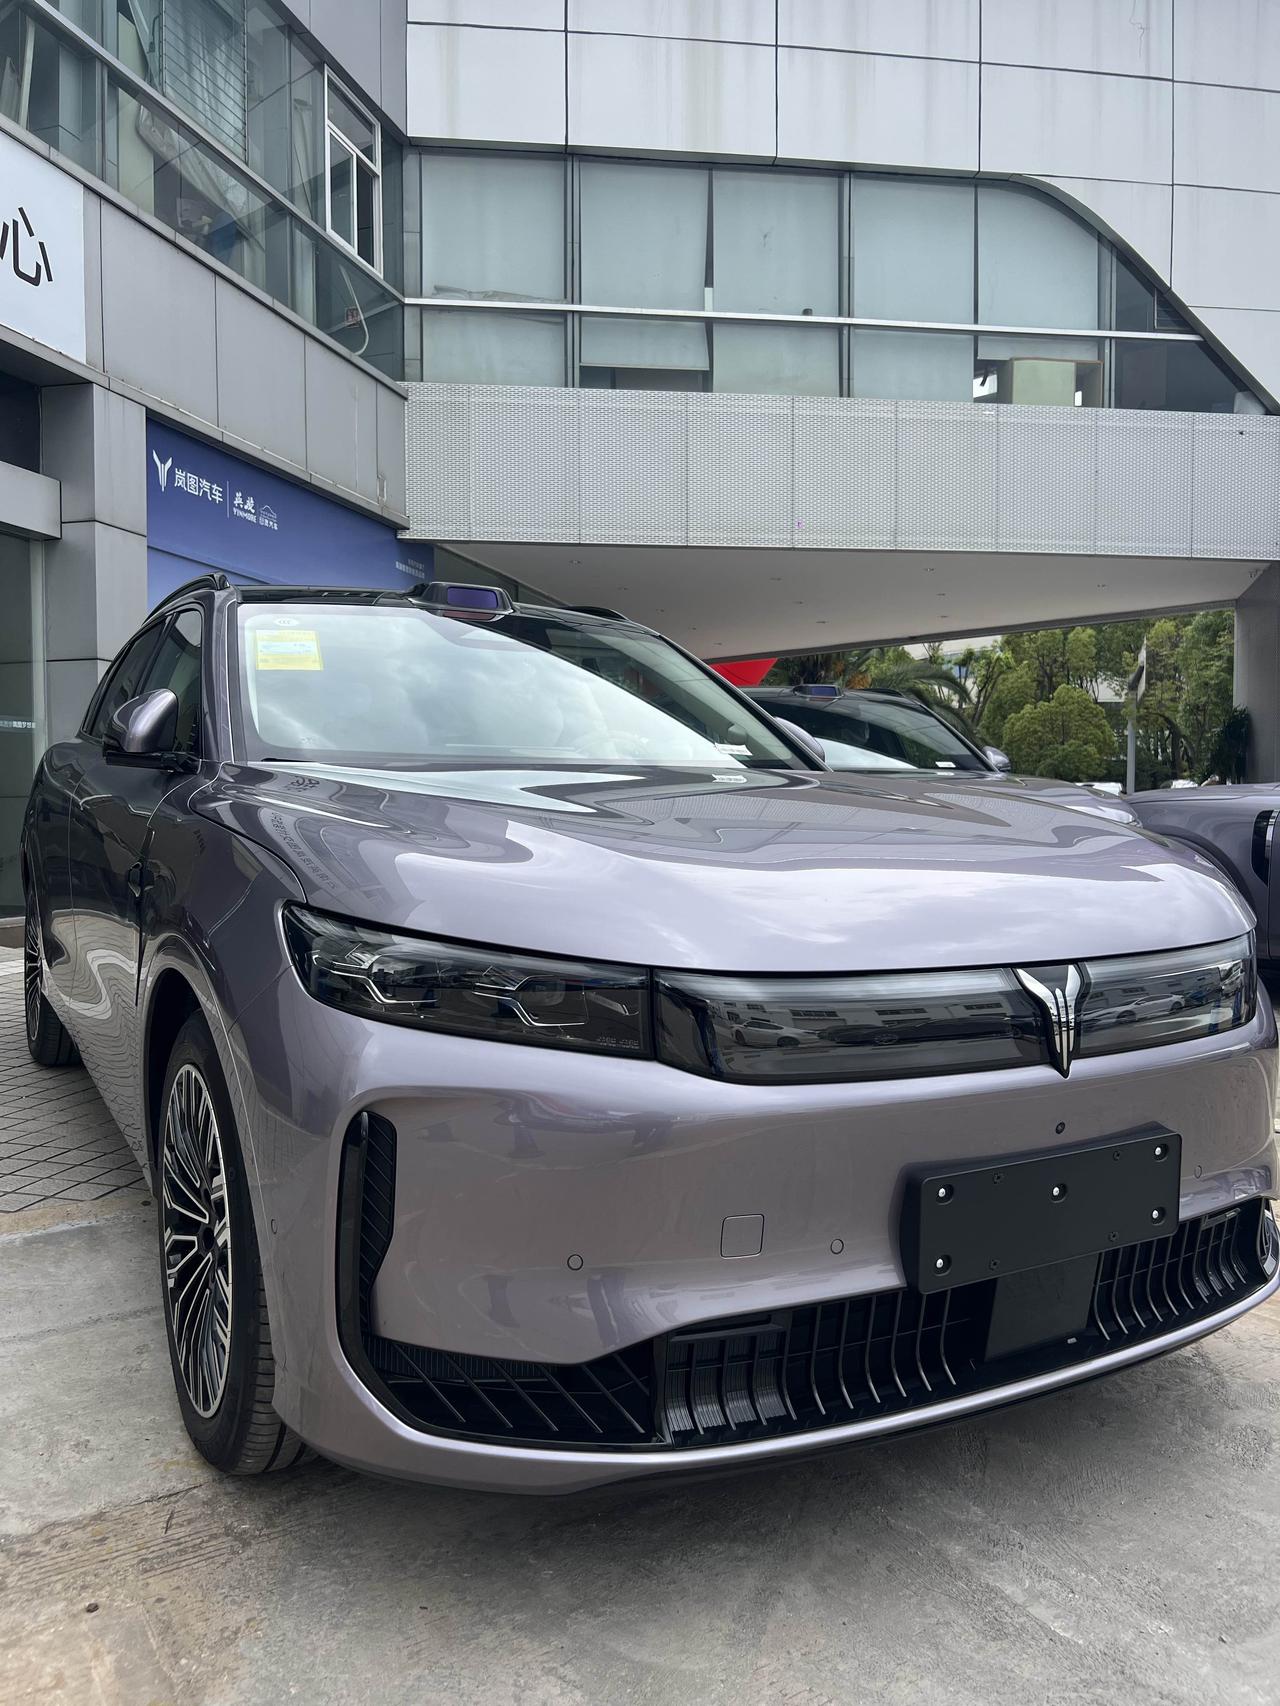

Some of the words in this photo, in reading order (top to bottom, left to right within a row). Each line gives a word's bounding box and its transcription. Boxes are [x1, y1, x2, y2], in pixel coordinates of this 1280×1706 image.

[0, 207, 53, 287] 心
[174, 467, 223, 504] 岚图汽车
